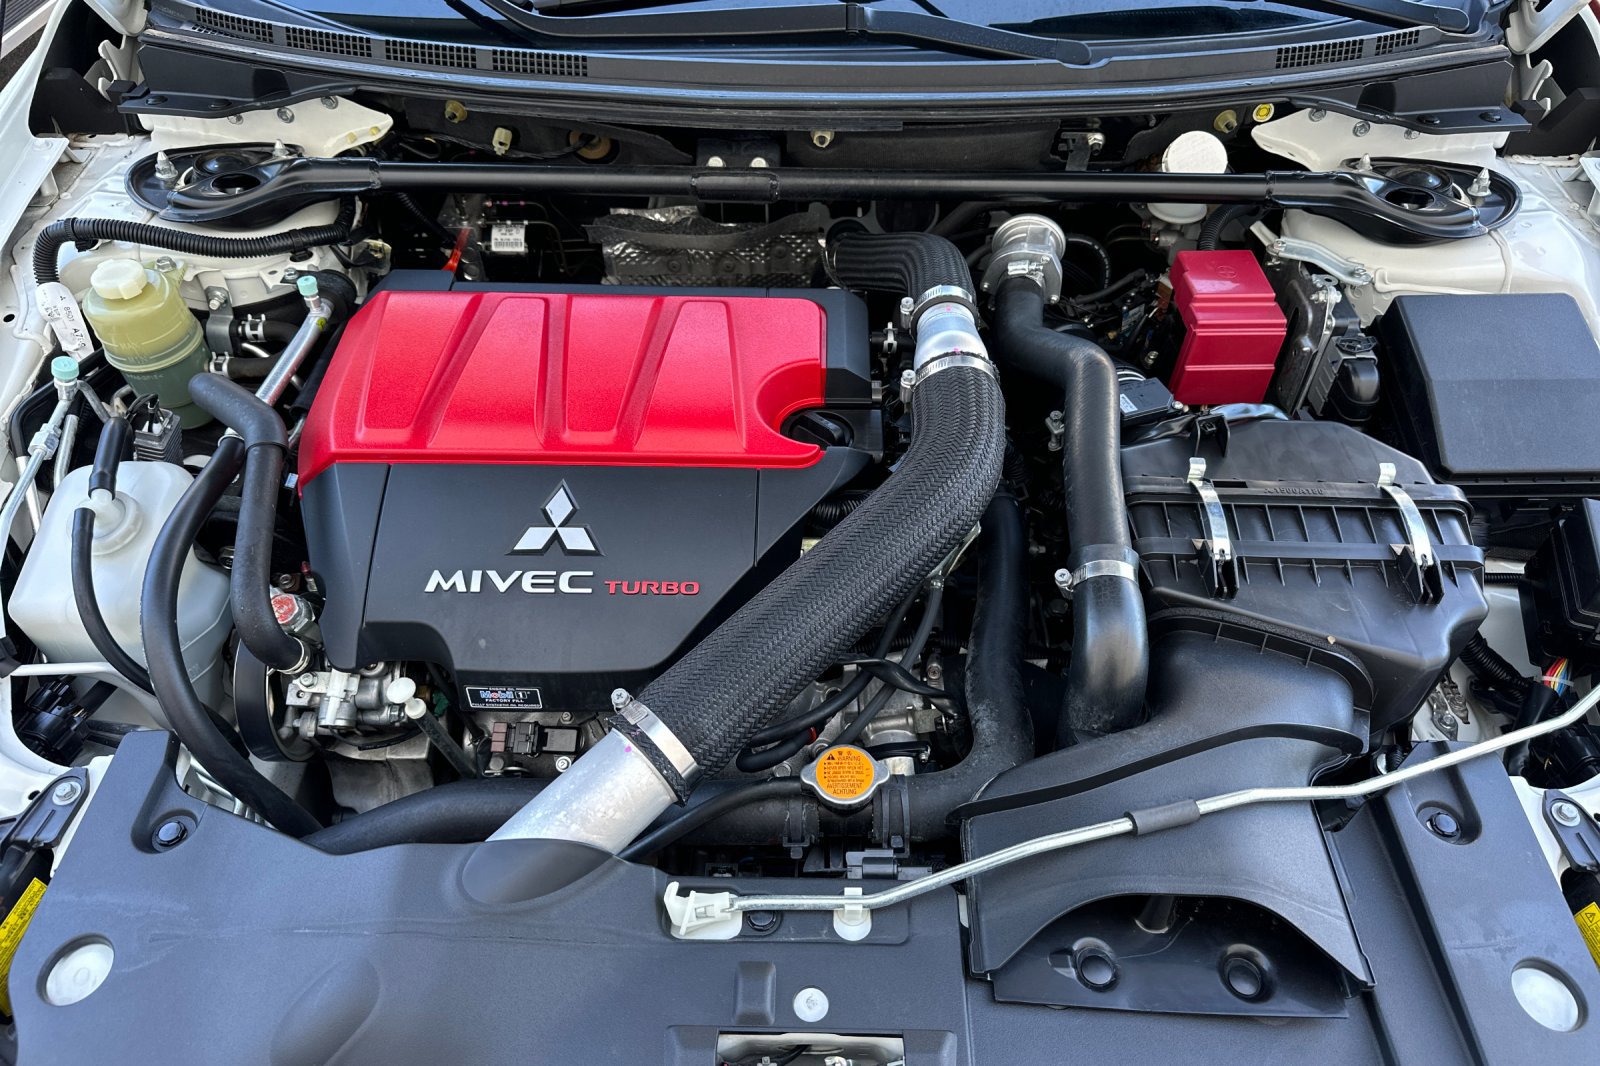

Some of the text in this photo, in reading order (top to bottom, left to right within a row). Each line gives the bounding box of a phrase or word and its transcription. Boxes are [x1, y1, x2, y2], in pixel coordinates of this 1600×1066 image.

[424, 569, 700, 595] MIVEC TURBO
[480, 690, 514, 698] Mobil
